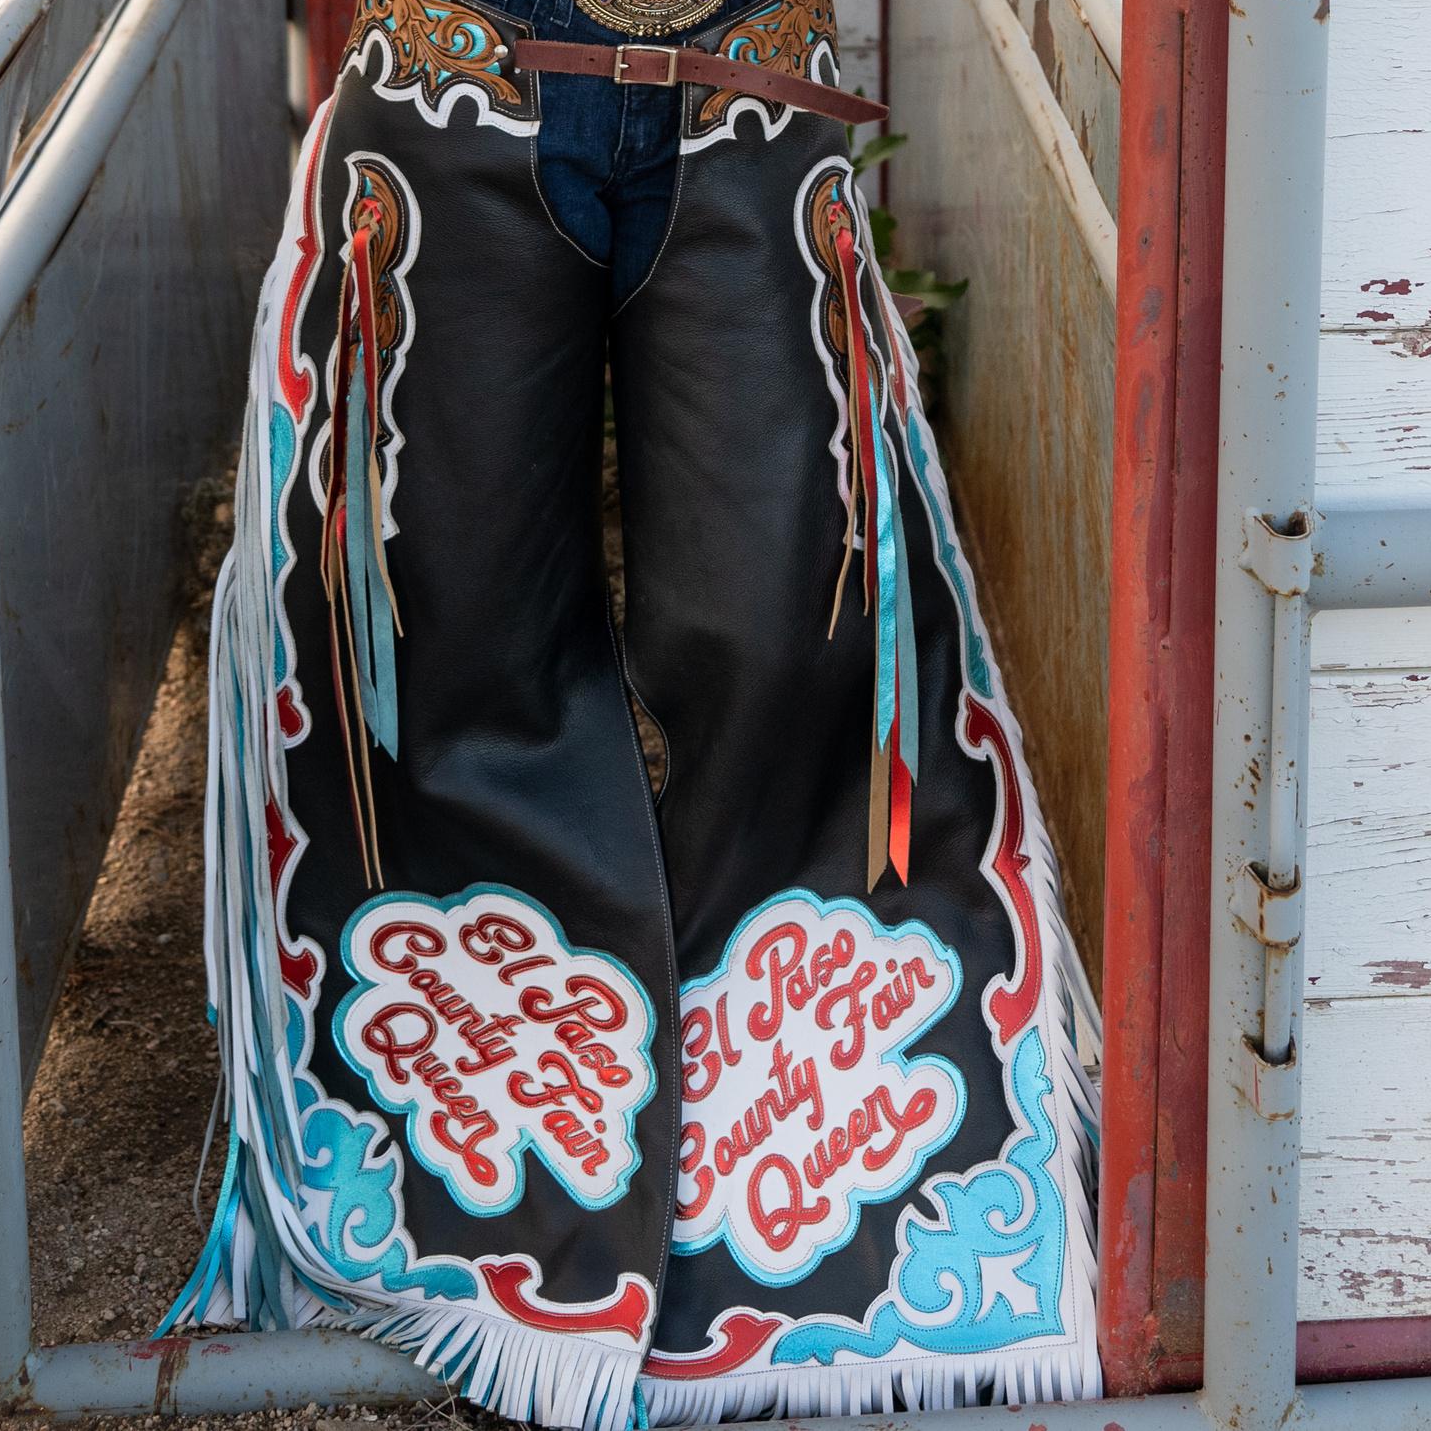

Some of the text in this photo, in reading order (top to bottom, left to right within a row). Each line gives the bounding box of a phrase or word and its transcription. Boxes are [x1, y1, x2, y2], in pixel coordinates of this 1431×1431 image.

[369, 921, 610, 1176] County Fair
[459, 912, 633, 1088] El Paso
[674, 956, 936, 1220] County Fair
[680, 921, 855, 1103] El Paso
[361, 1001, 499, 1187] Queen
[747, 1085, 938, 1252] Queen
